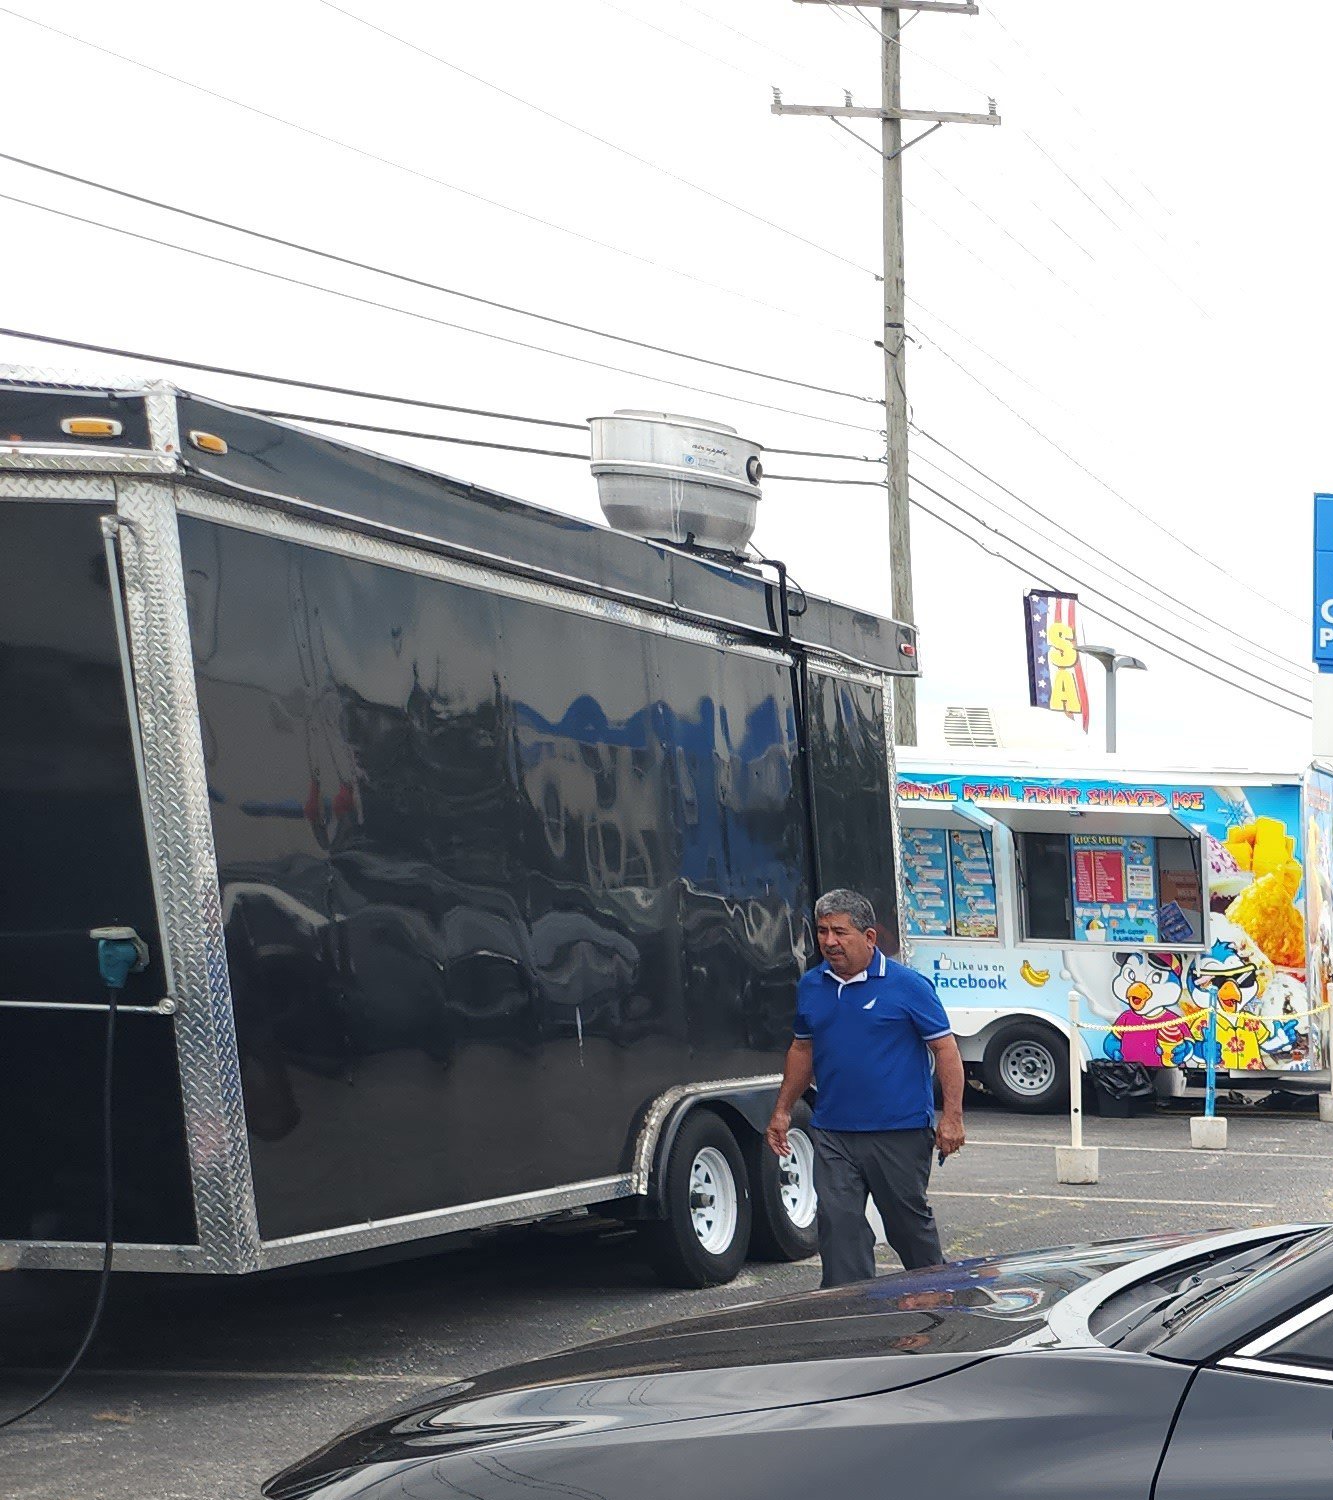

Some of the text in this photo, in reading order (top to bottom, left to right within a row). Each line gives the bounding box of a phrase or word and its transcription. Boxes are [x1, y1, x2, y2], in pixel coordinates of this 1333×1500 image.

[963, 782, 1016, 802] REAL
[1023, 785, 1080, 805] FRUIT
[1087, 785, 1167, 807] SHAVED
[1171, 790, 1205, 811] ICE
[952, 960, 1005, 972] Like us on
[932, 972, 1008, 990] facebook
